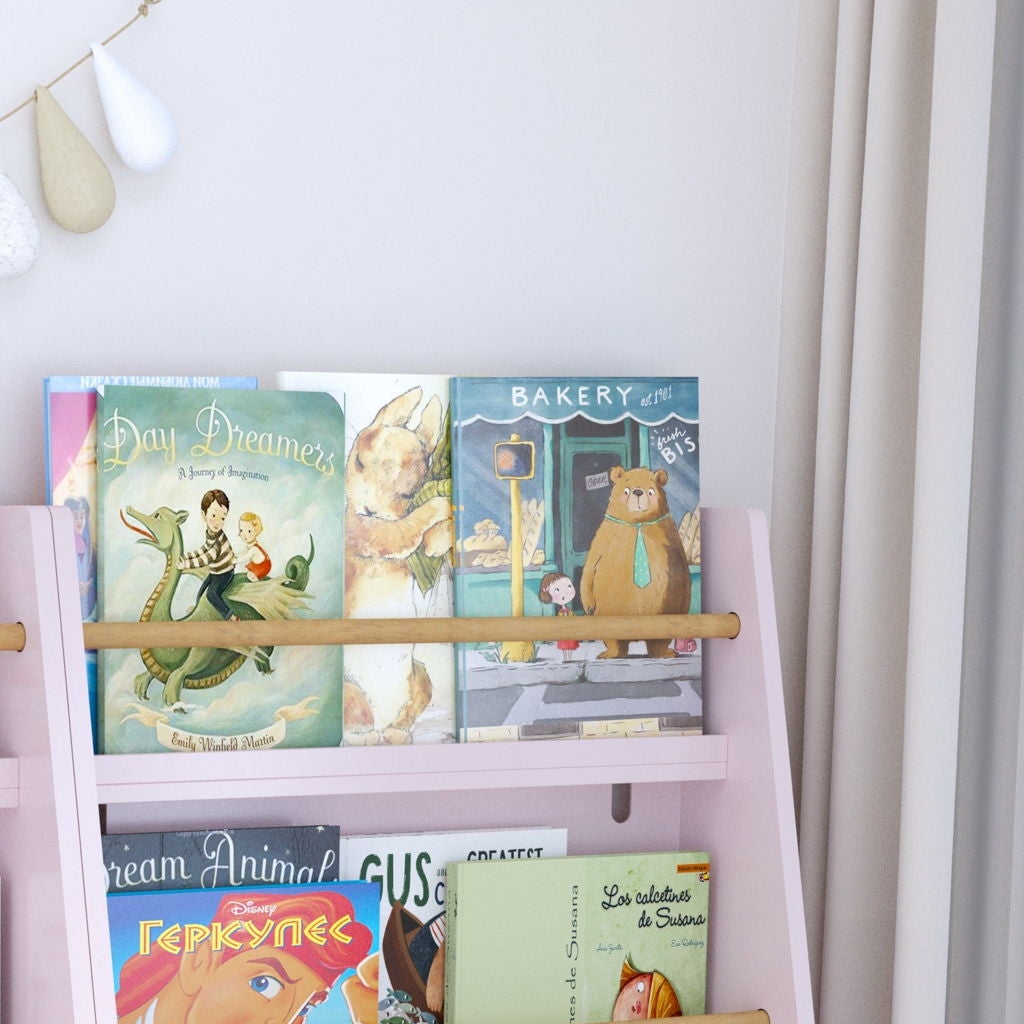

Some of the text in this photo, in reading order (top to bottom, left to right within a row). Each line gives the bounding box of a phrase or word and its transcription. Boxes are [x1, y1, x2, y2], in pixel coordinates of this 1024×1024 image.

[512, 386, 632, 407] BAKERY
[103, 398, 335, 476] Day Dreamers
[657, 427, 686, 450] fresh
[660, 436, 696, 465] BIS
[178, 465, 269, 482] A Journey of Imagination
[171, 732, 196, 752] Emily
[242, 734, 275, 751] Martin
[107, 831, 339, 893] ream Animal
[359, 851, 432, 907] GUS
[228, 900, 277, 916] Disney
[601, 884, 691, 910] Los calcetines
[566, 884, 579, 961] Susana
[638, 906, 706, 928] de Susana
[138, 914, 355, 956] ГЕРКУЛЕС
[565, 966, 577, 990] de
